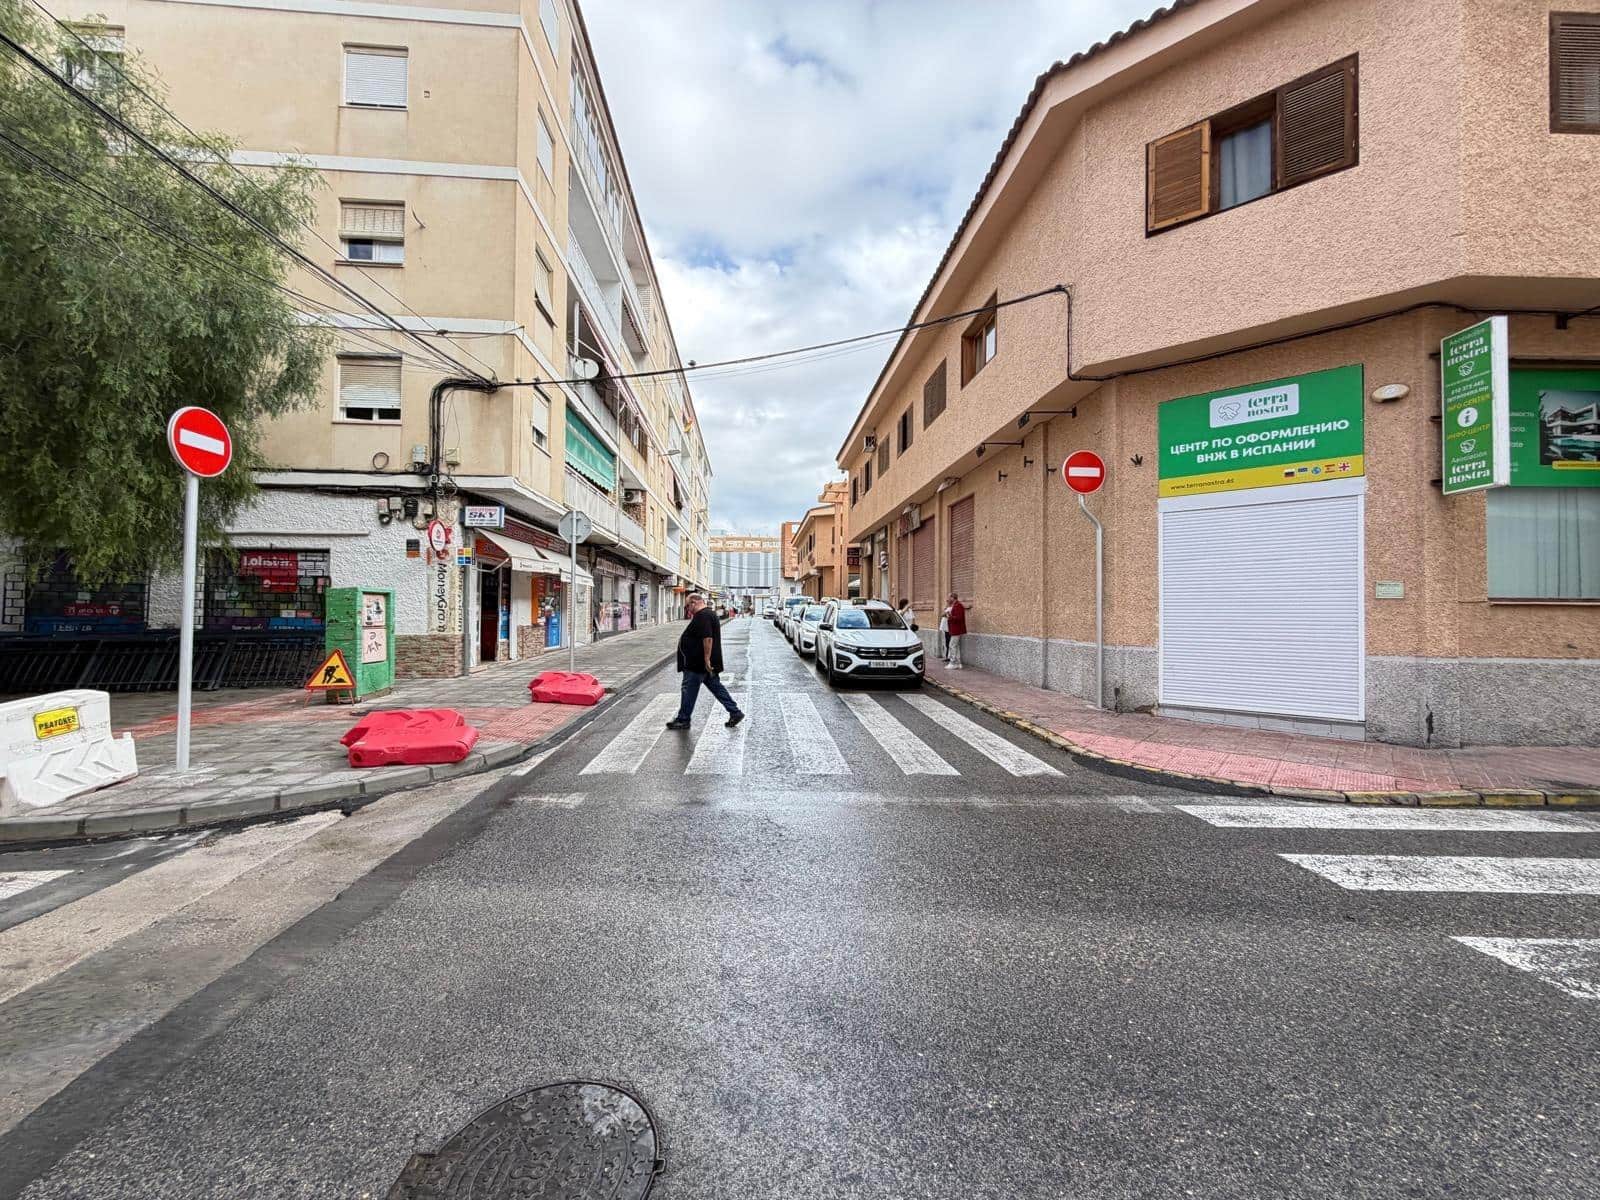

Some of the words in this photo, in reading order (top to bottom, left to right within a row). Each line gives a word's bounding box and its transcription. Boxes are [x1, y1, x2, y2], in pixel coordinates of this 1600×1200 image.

[1449, 336, 1484, 356] terra
[1447, 345, 1489, 367] nostra
[1247, 393, 1288, 409] terra
[1247, 404, 1289, 418] nostra
[1170, 440, 1209, 455] ЦЕНТР
[1211, 437, 1233, 449] ПО
[1235, 419, 1350, 445] ОФОРМЛЕНИЮ
[1196, 451, 1228, 464] ВНЖ
[1230, 448, 1239, 459] В
[1242, 438, 1316, 457] ИСПАНИИ
[1452, 460, 1486, 474] terra
[1448, 469, 1491, 485] nostra
[436, 562, 447, 633] MoneyGram
[38, 715, 77, 731] PEATONES
